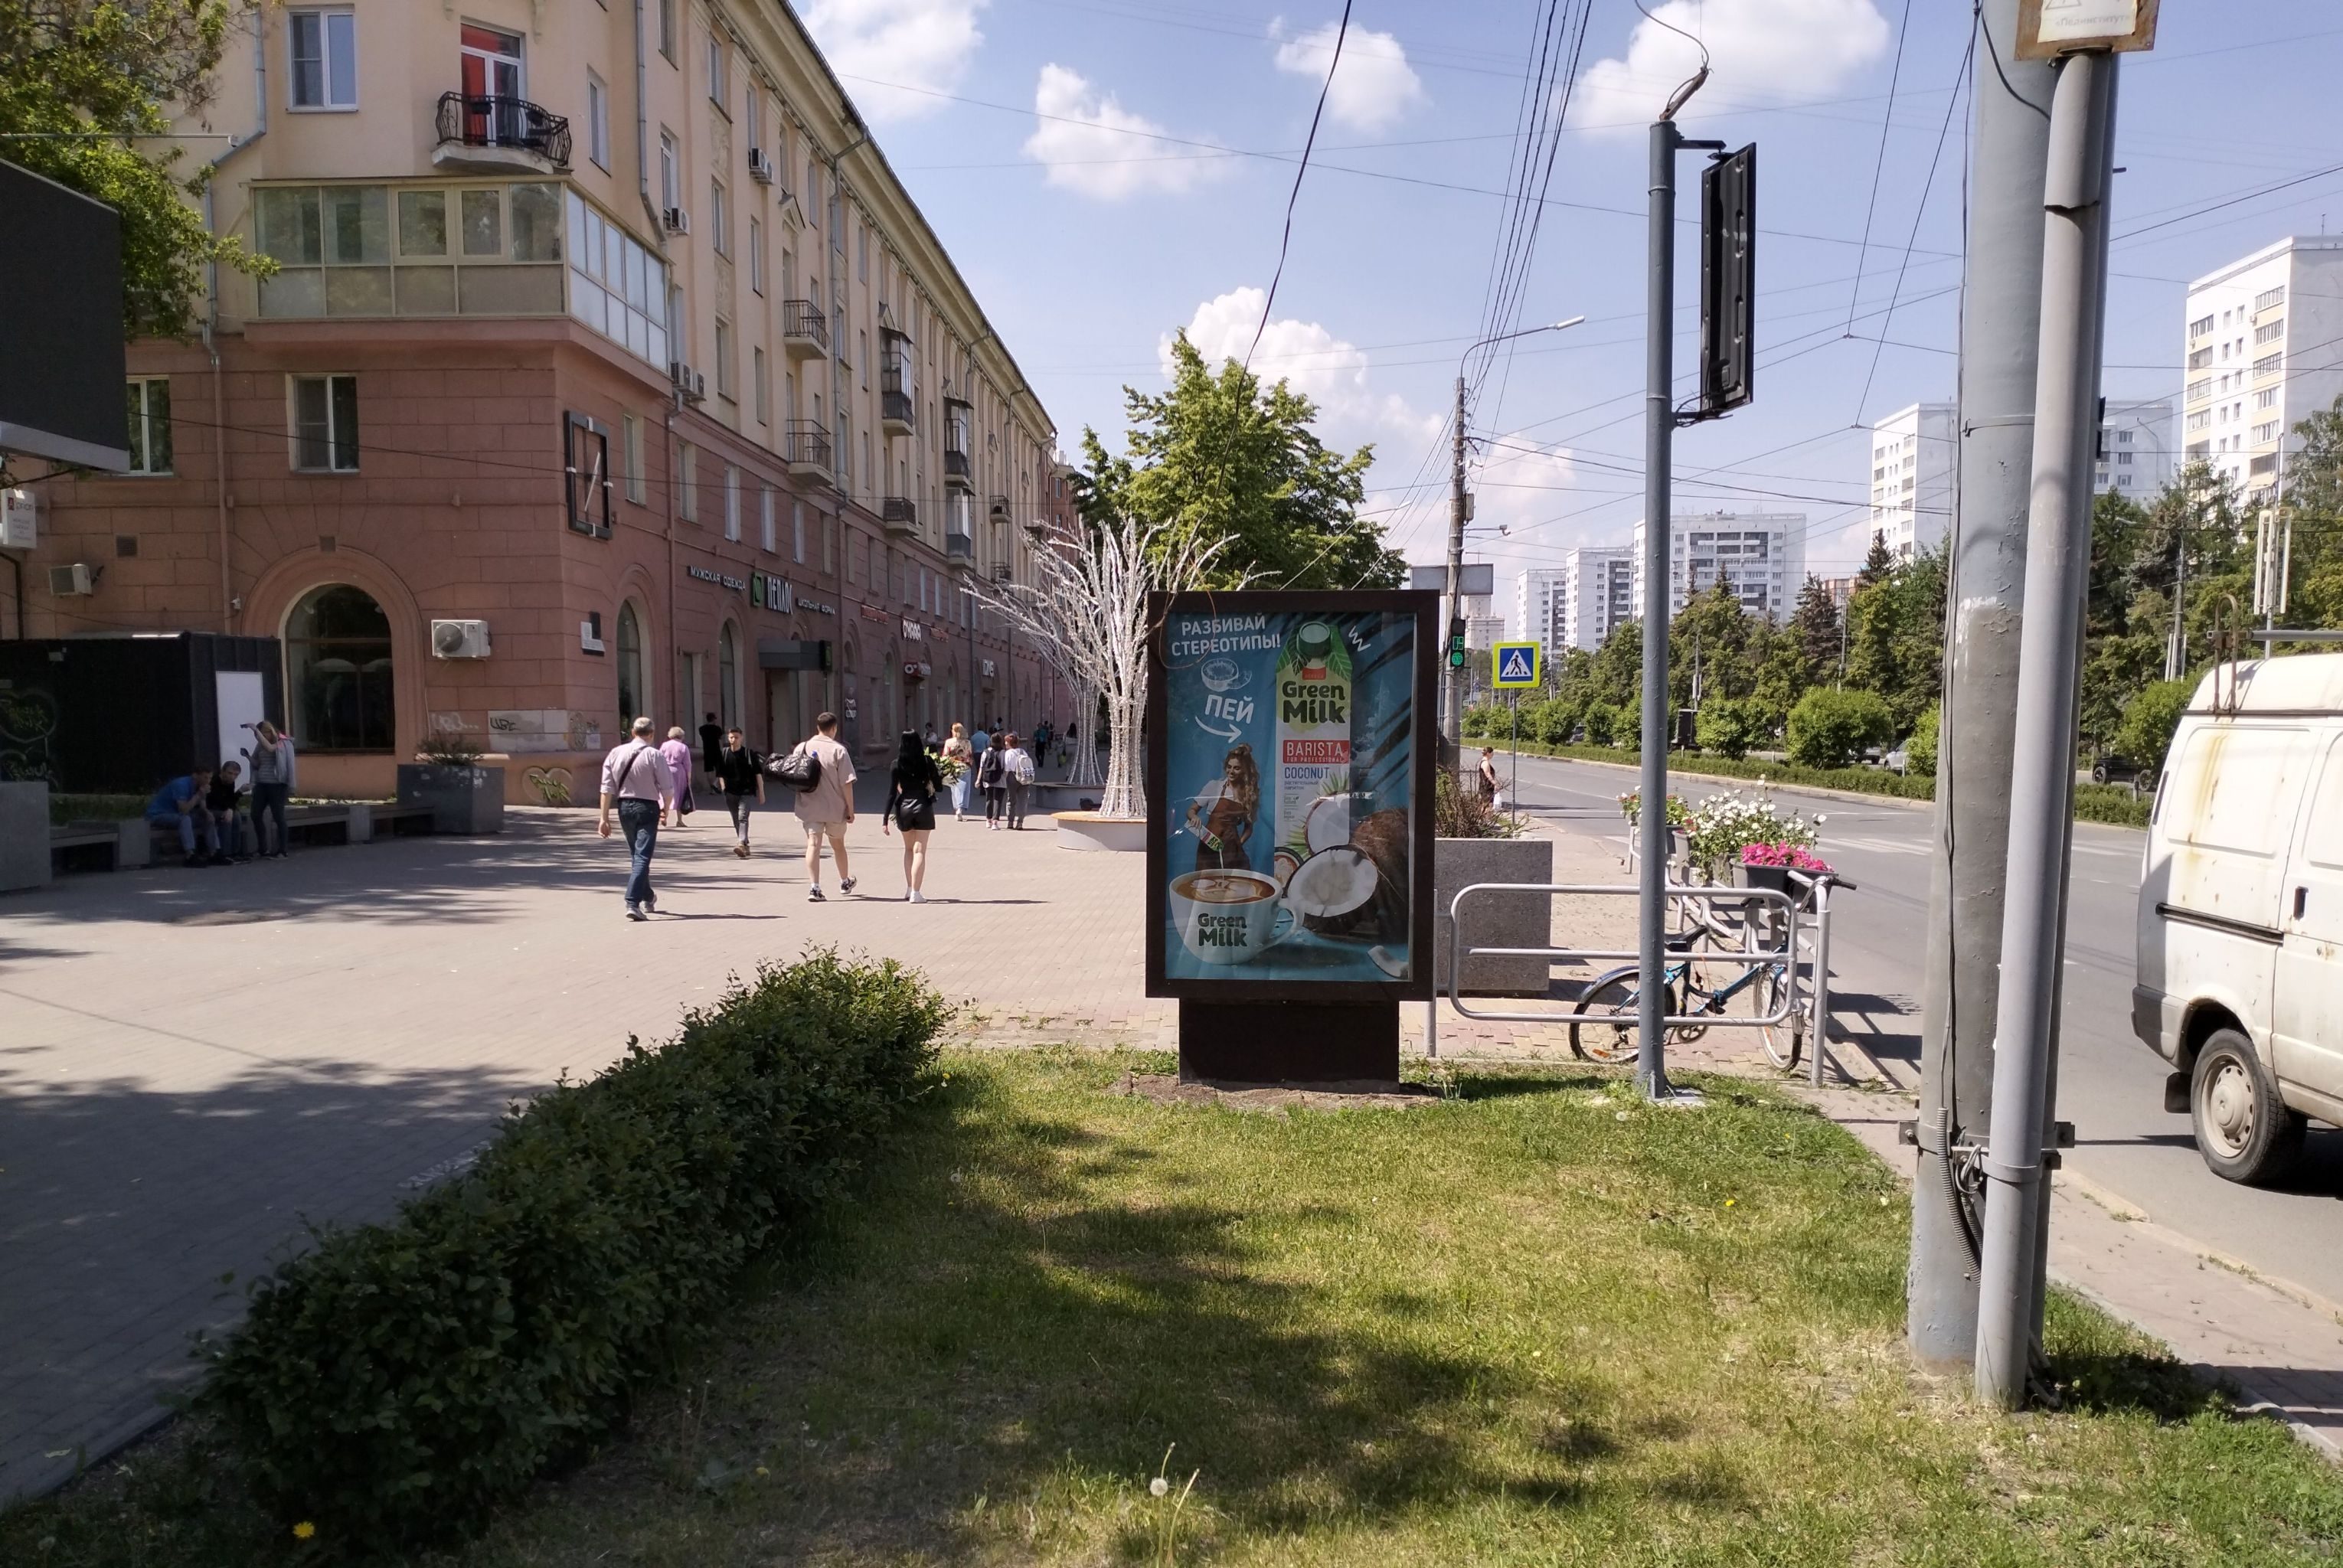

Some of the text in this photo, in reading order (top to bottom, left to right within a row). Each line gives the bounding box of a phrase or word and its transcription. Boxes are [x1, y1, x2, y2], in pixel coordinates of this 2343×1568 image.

[690, 566, 746, 591] МУЖСКАЯ ОДЕЖДА
[1181, 612, 1266, 636] РАЗБИВАЙ
[1172, 633, 1281, 656] СТЕРЕОТИПЫ!
[1282, 680, 1345, 701] Green
[1204, 693, 1254, 724] ПЕЙ
[1283, 698, 1346, 724] Milk
[1286, 742, 1343, 756] BARISTA
[1284, 766, 1330, 779] COCONUT
[1198, 913, 1247, 929] Green
[1198, 927, 1247, 946] Milk
